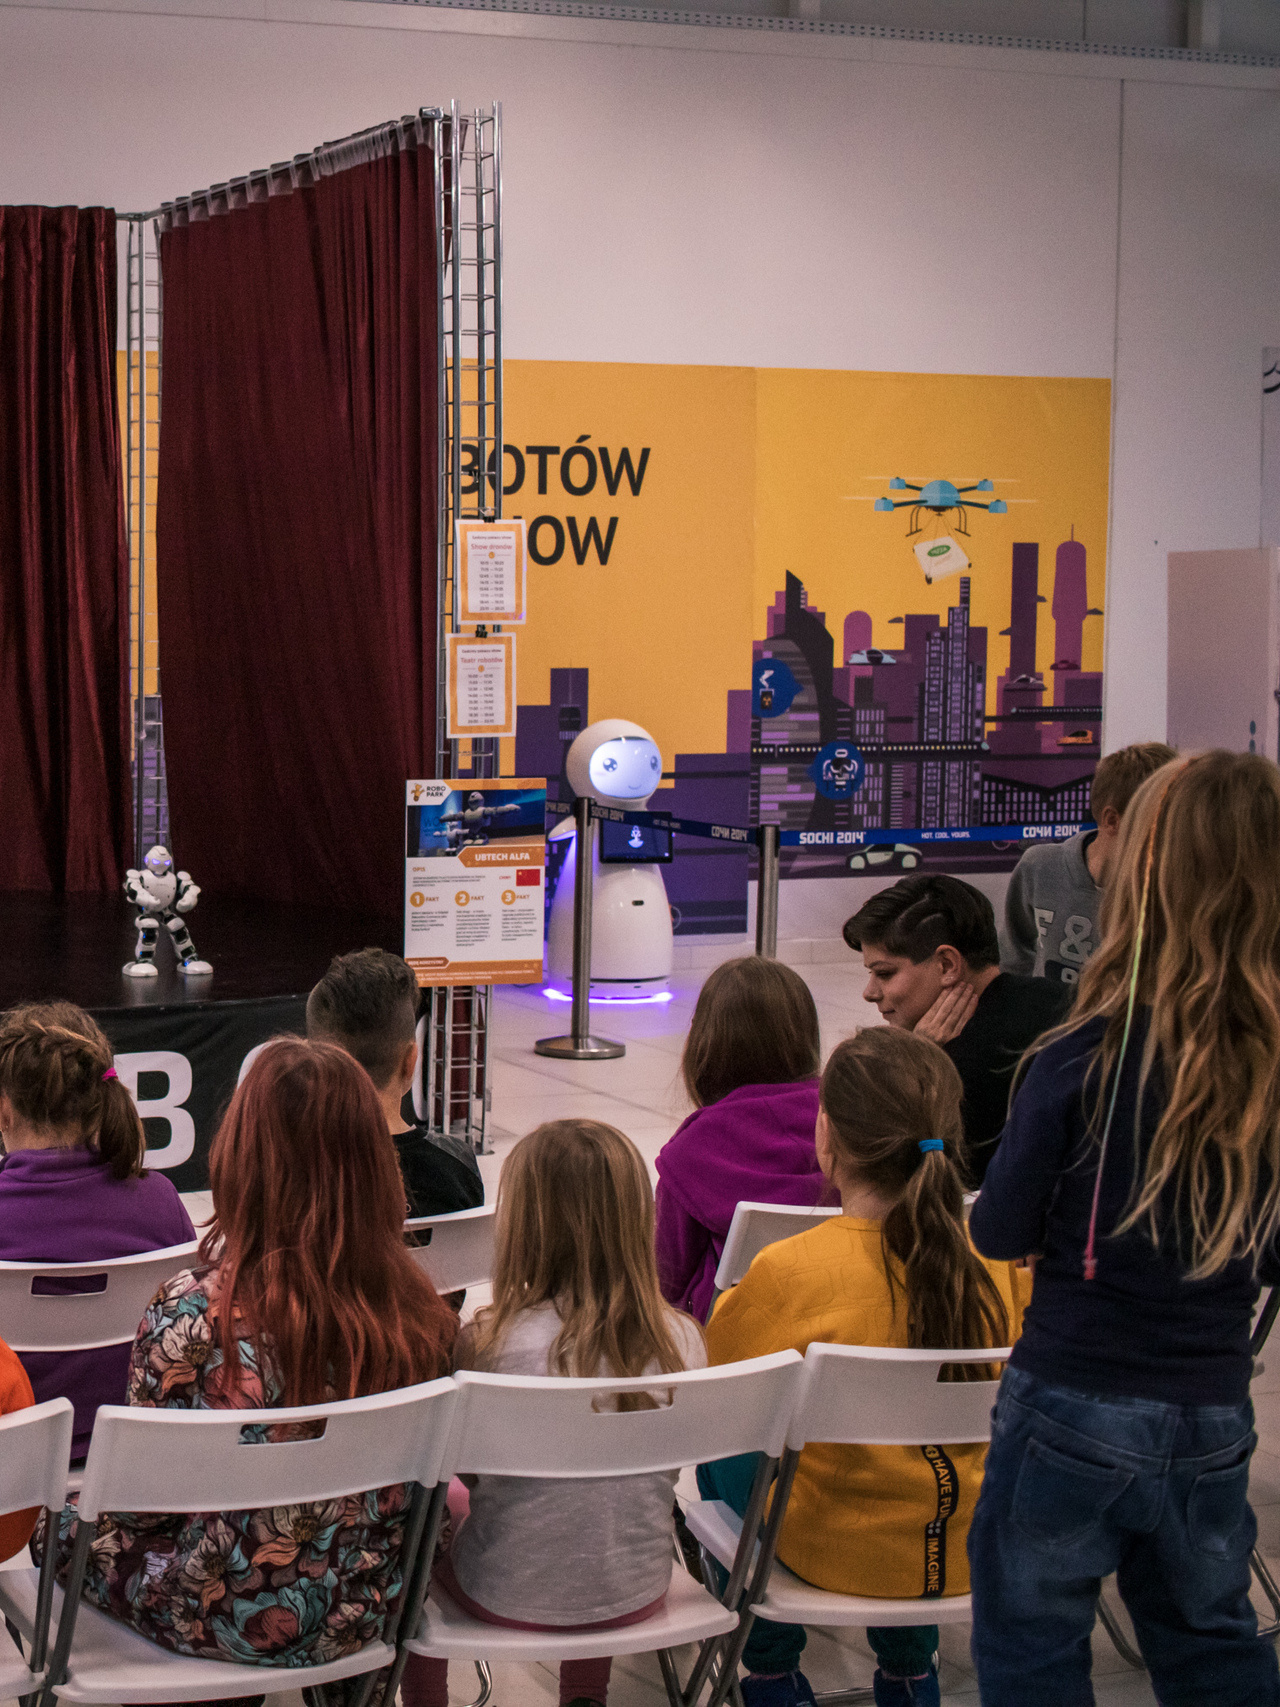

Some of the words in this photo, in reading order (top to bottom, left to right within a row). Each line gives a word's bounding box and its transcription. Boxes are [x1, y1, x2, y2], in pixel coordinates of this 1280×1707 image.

[730, 829, 748, 842] 2014
[1054, 825, 1080, 837] 2014
[799, 831, 834, 844] SOCHI
[836, 831, 864, 844] 2014
[414, 895, 420, 904] 1
[459, 894, 466, 904] 2
[505, 892, 512, 902] 3
[932, 1458, 952, 1495] HAVE
[928, 1538, 939, 1592] IMAGINE
